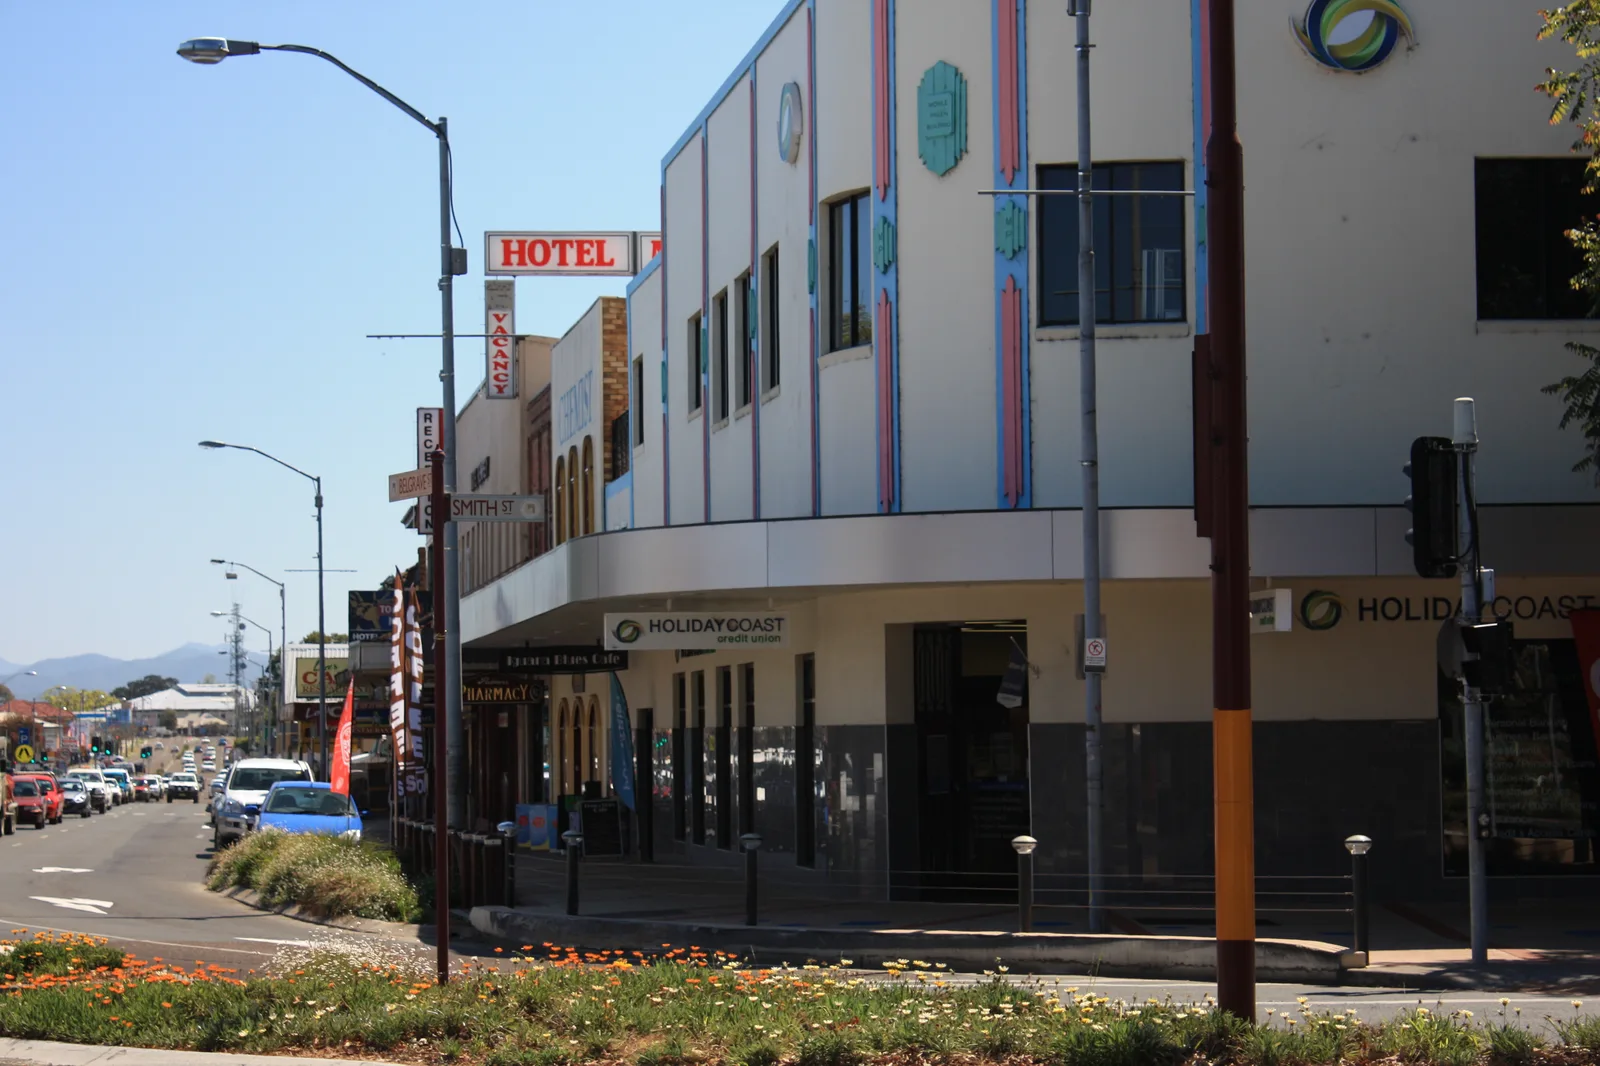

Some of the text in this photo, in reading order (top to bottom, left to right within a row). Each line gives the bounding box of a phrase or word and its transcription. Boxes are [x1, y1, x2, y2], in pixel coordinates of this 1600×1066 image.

[501, 239, 615, 267] HOTEL
[492, 313, 509, 394] VACANCY
[423, 413, 433, 529] RECEION
[398, 474, 427, 494] BELGRAVE
[453, 499, 514, 517] SMITH ST
[717, 634, 781, 643] credit union
[554, 653, 588, 665] Blues
